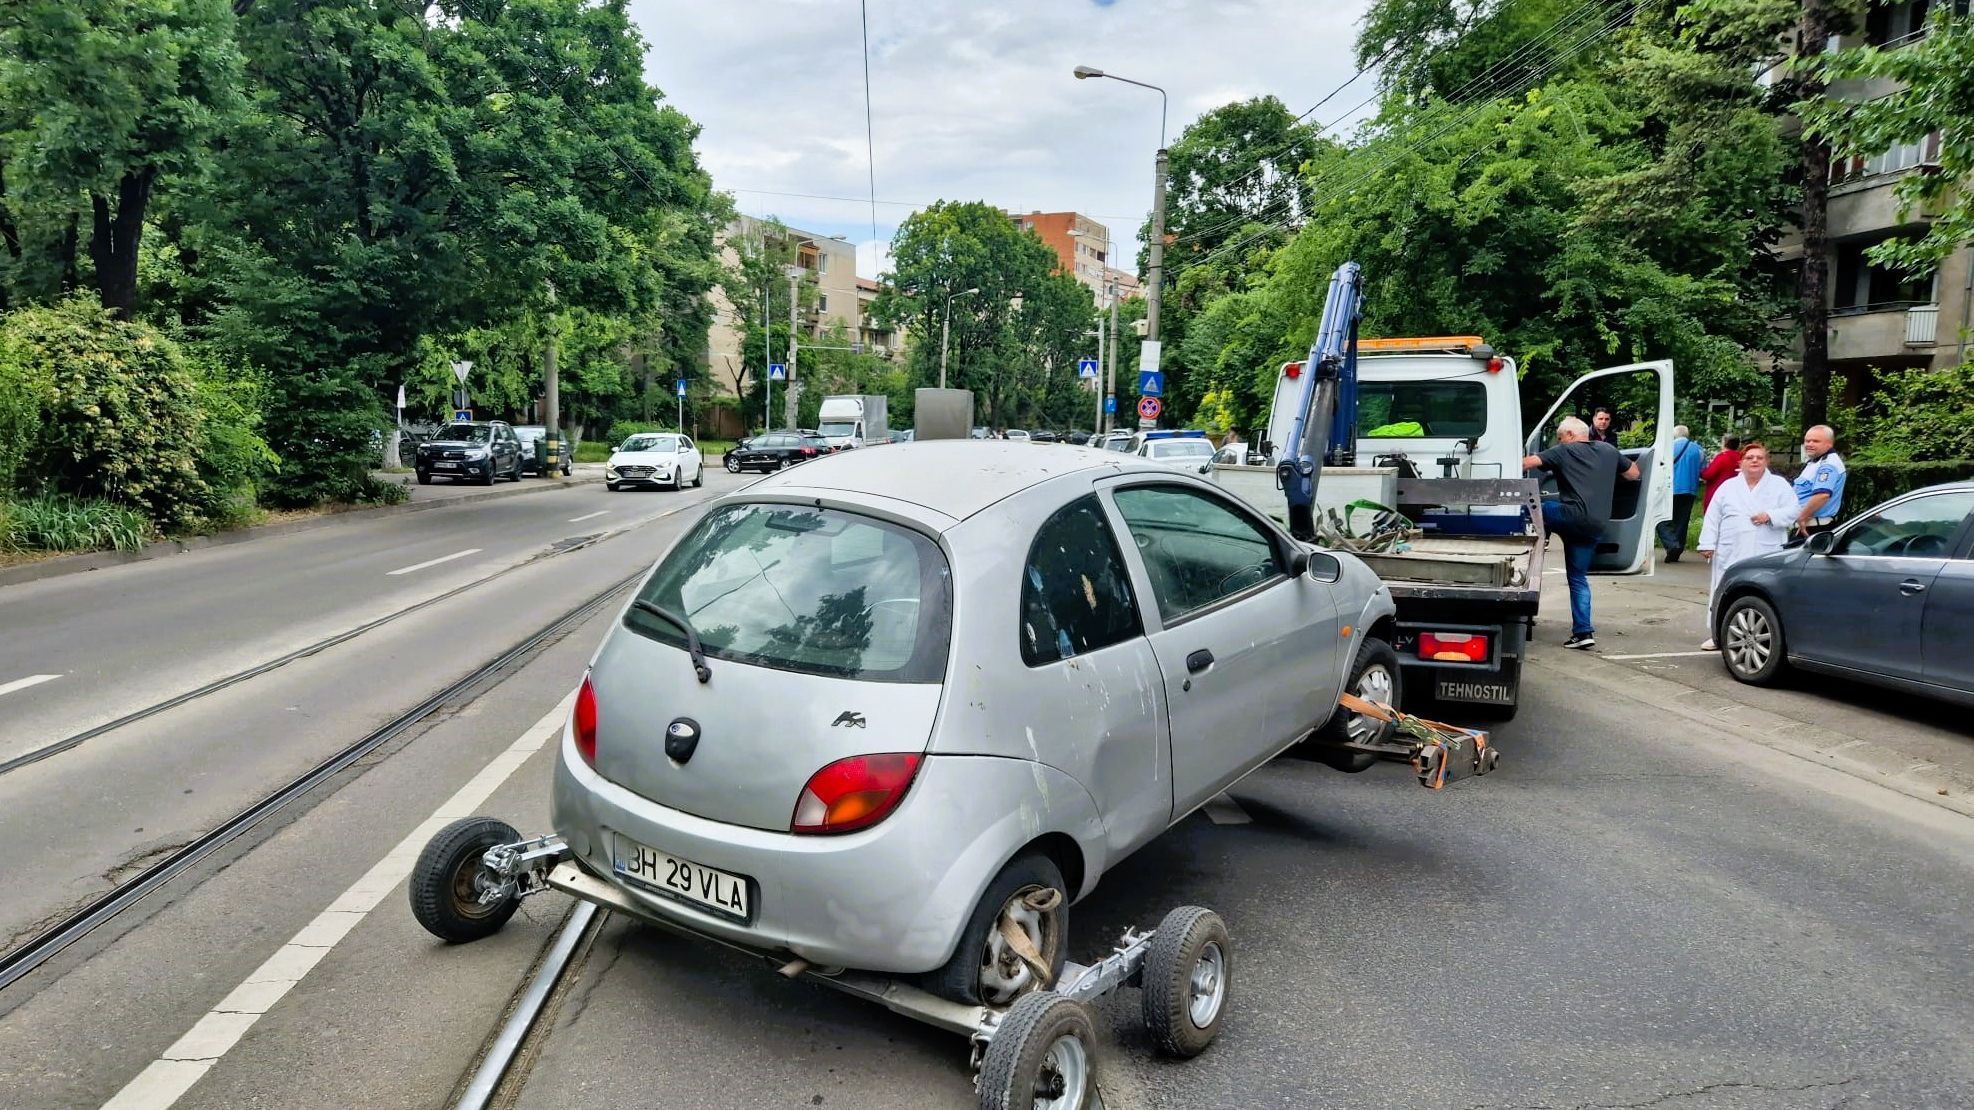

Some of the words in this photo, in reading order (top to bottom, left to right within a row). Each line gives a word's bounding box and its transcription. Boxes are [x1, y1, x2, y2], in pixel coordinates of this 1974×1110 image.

[1440, 682, 1510, 701] TEHNOSTIL
[666, 858, 692, 892] 29
[698, 868, 743, 911] VLA
